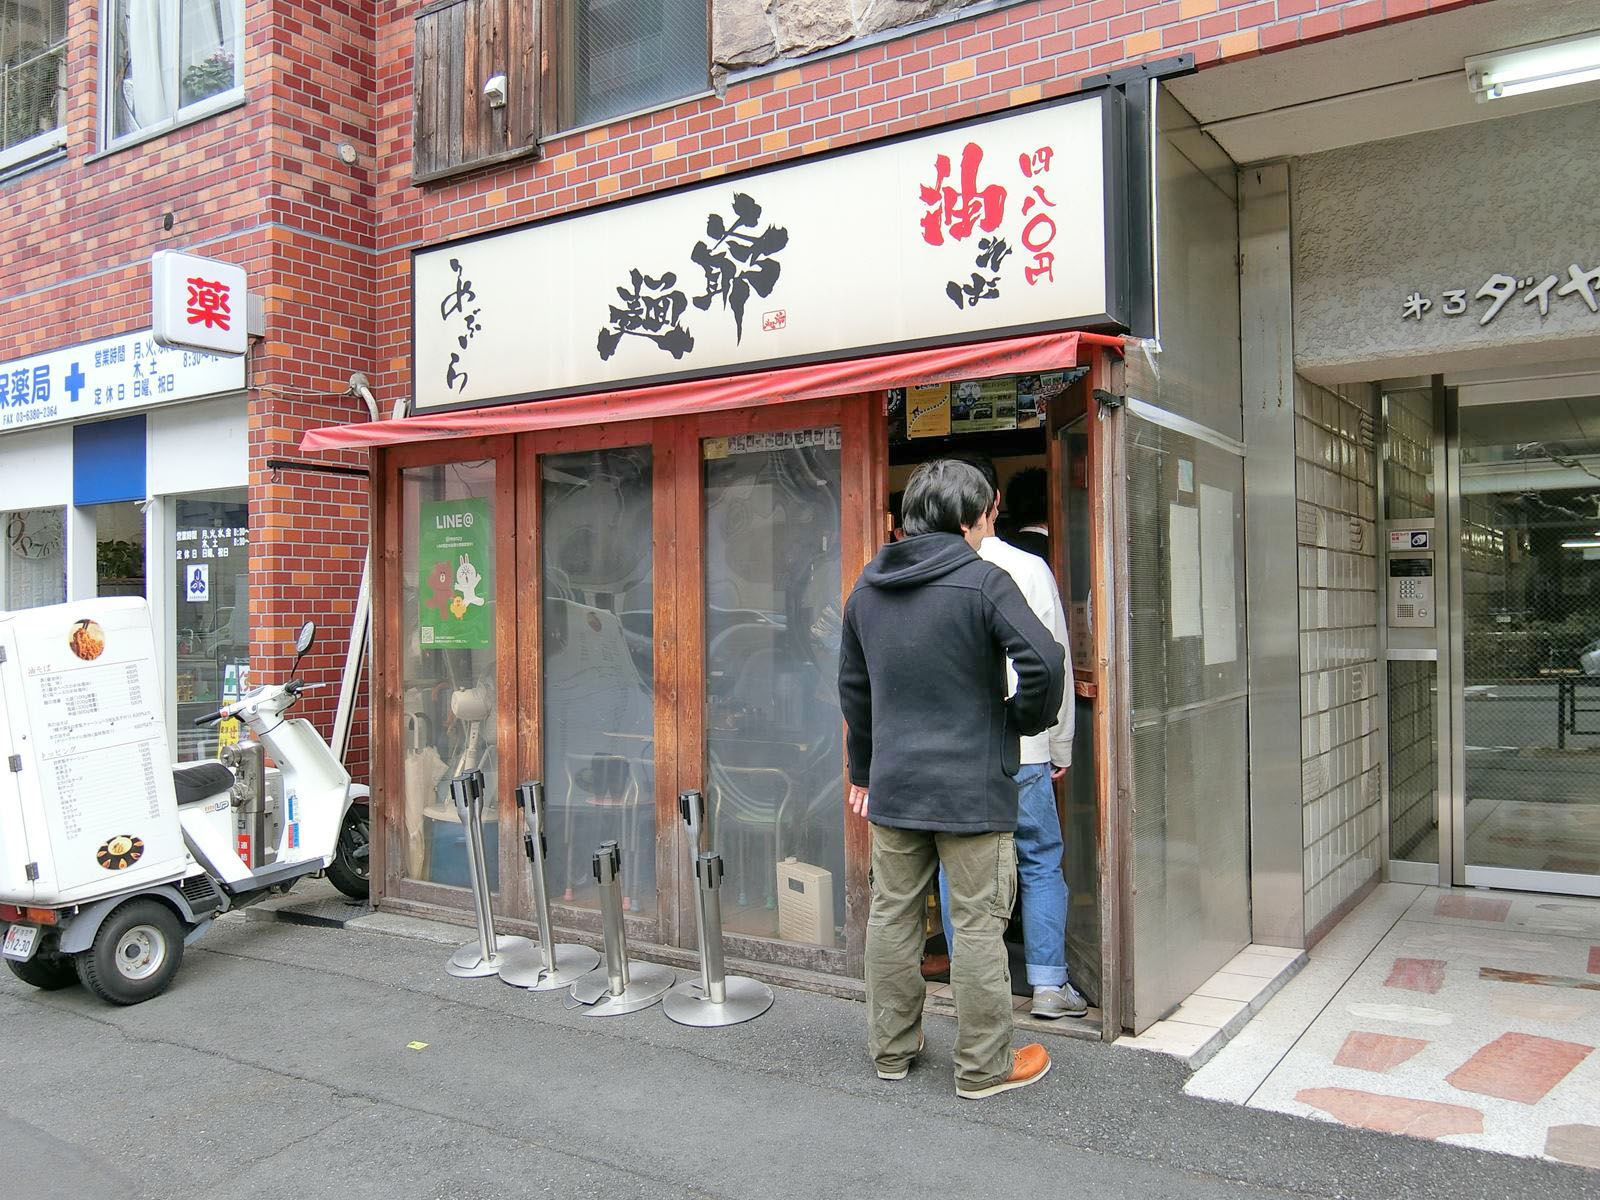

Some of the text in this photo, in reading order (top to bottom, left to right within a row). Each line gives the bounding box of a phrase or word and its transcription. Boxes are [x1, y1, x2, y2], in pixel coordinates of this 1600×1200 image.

[186, 277, 232, 332] 薬
[441, 258, 482, 394] あぶら
[94, 344, 126, 368] 営業時間
[94, 383, 125, 405] 定休日
[3, 413, 13, 425] FAX
[436, 512, 474, 529] LINE@
